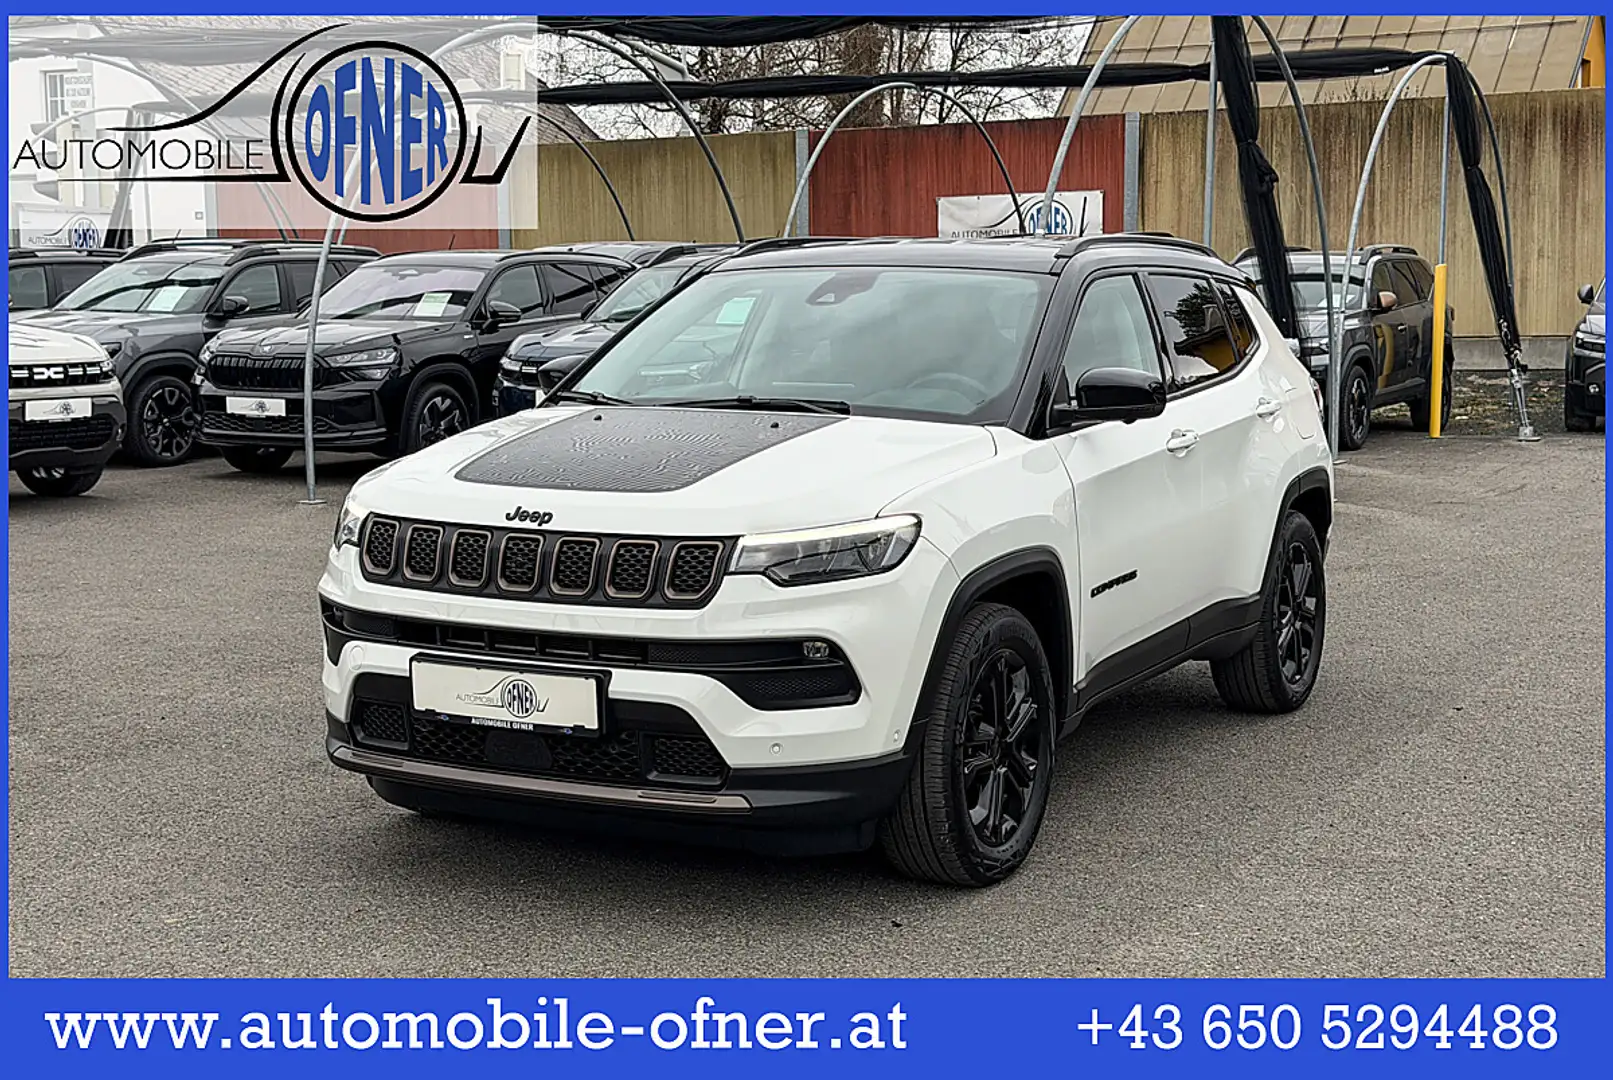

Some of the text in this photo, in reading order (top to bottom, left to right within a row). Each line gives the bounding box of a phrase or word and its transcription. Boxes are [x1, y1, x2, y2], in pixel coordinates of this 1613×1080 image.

[505, 505, 553, 527] Jeep
[471, 718, 534, 731] AUTOMOBILE OFNER
